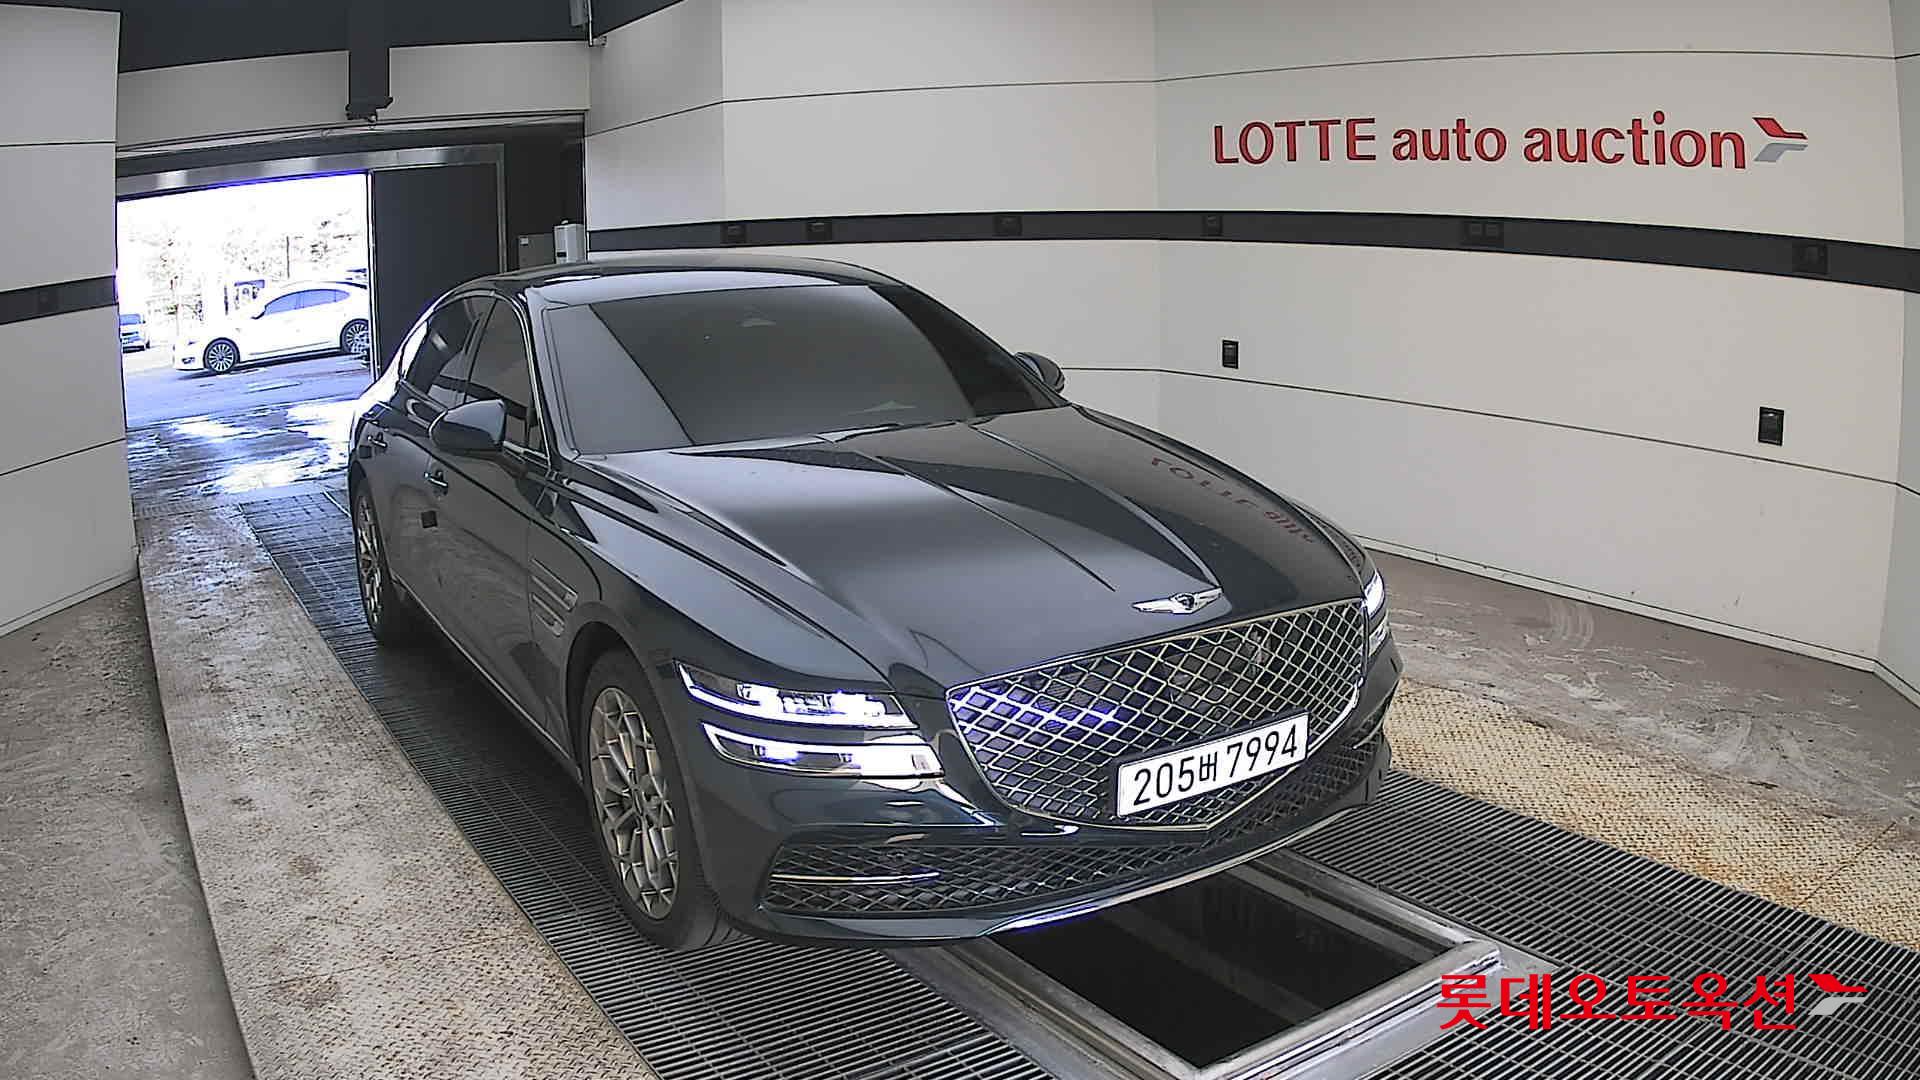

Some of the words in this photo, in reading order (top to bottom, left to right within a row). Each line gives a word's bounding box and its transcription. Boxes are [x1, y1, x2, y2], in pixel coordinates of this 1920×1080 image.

[1213, 118, 1376, 164] LOTTE
[1392, 118, 1507, 162] auto
[1523, 111, 1747, 169] auction
[1226, 725, 1297, 778] 7994
